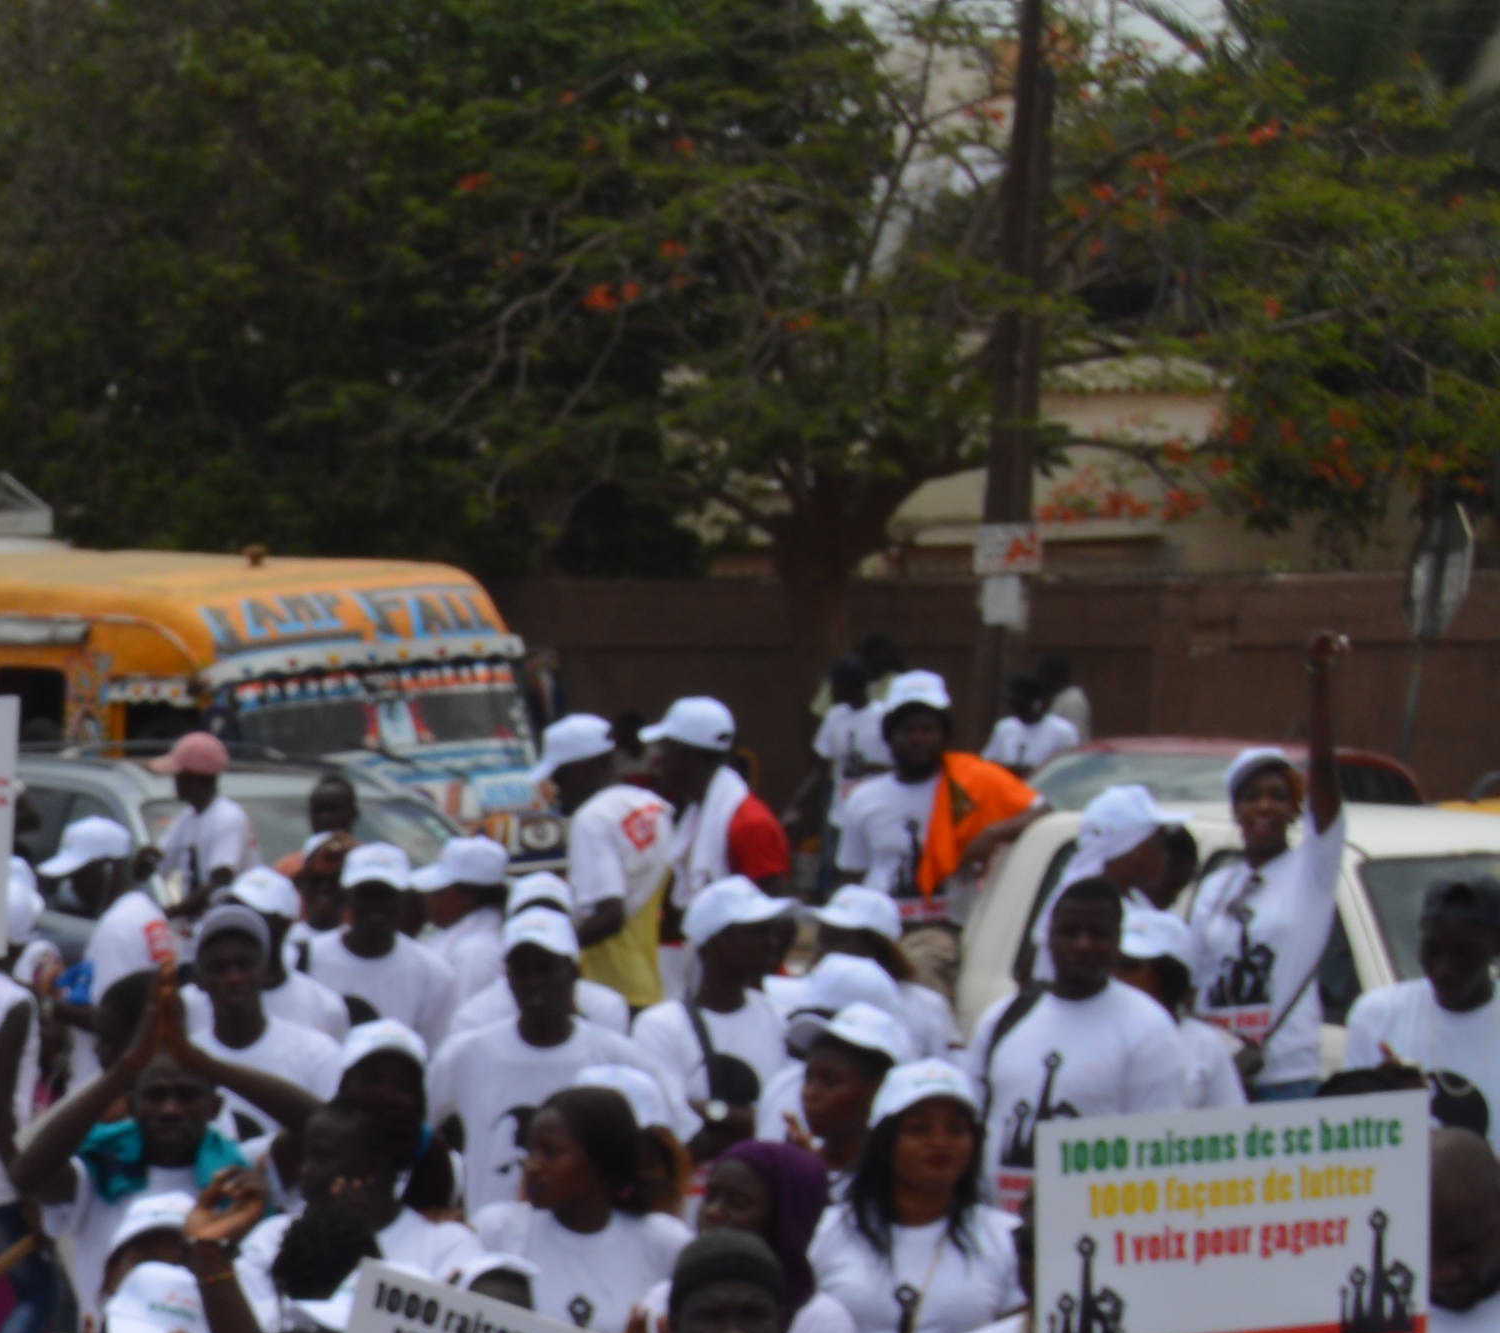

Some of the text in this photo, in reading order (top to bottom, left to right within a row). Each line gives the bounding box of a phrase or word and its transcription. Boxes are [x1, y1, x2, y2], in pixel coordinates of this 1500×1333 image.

[1060, 1117, 1403, 1176] 1000 raisons de se battre
[1089, 1180, 1159, 1219] 1000
[1262, 1169, 1293, 1203] de
[1298, 1165, 1376, 1200] lutter
[1132, 1226, 1187, 1262] voix
[1194, 1225, 1253, 1265] pour
[1259, 1217, 1349, 1259] gagner
[374, 1280, 441, 1326] 1000
